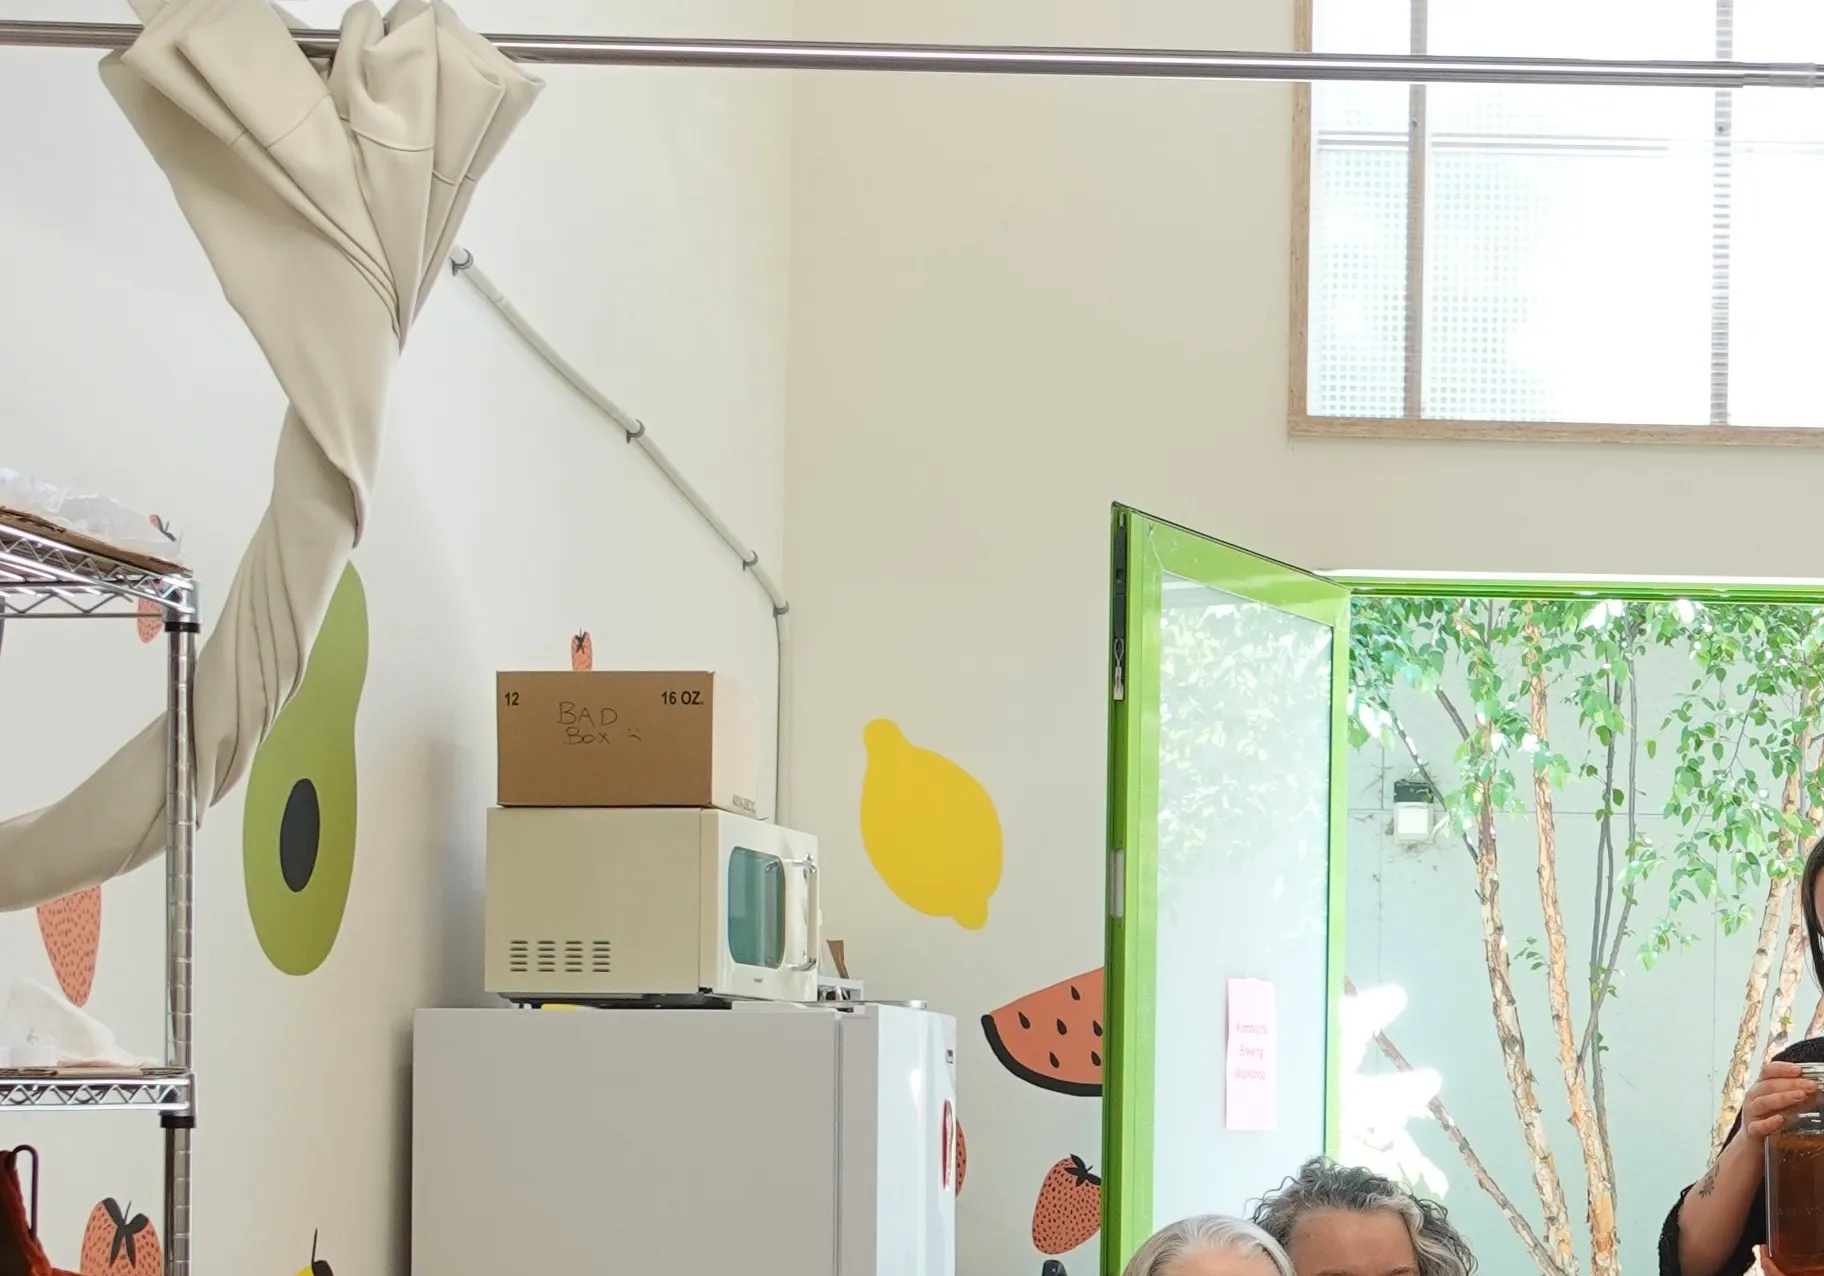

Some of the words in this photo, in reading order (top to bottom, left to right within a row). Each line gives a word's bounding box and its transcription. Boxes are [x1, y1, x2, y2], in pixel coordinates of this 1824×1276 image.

[504, 692, 520, 706] 12
[661, 691, 677, 706] 16
[557, 701, 618, 727] BAD
